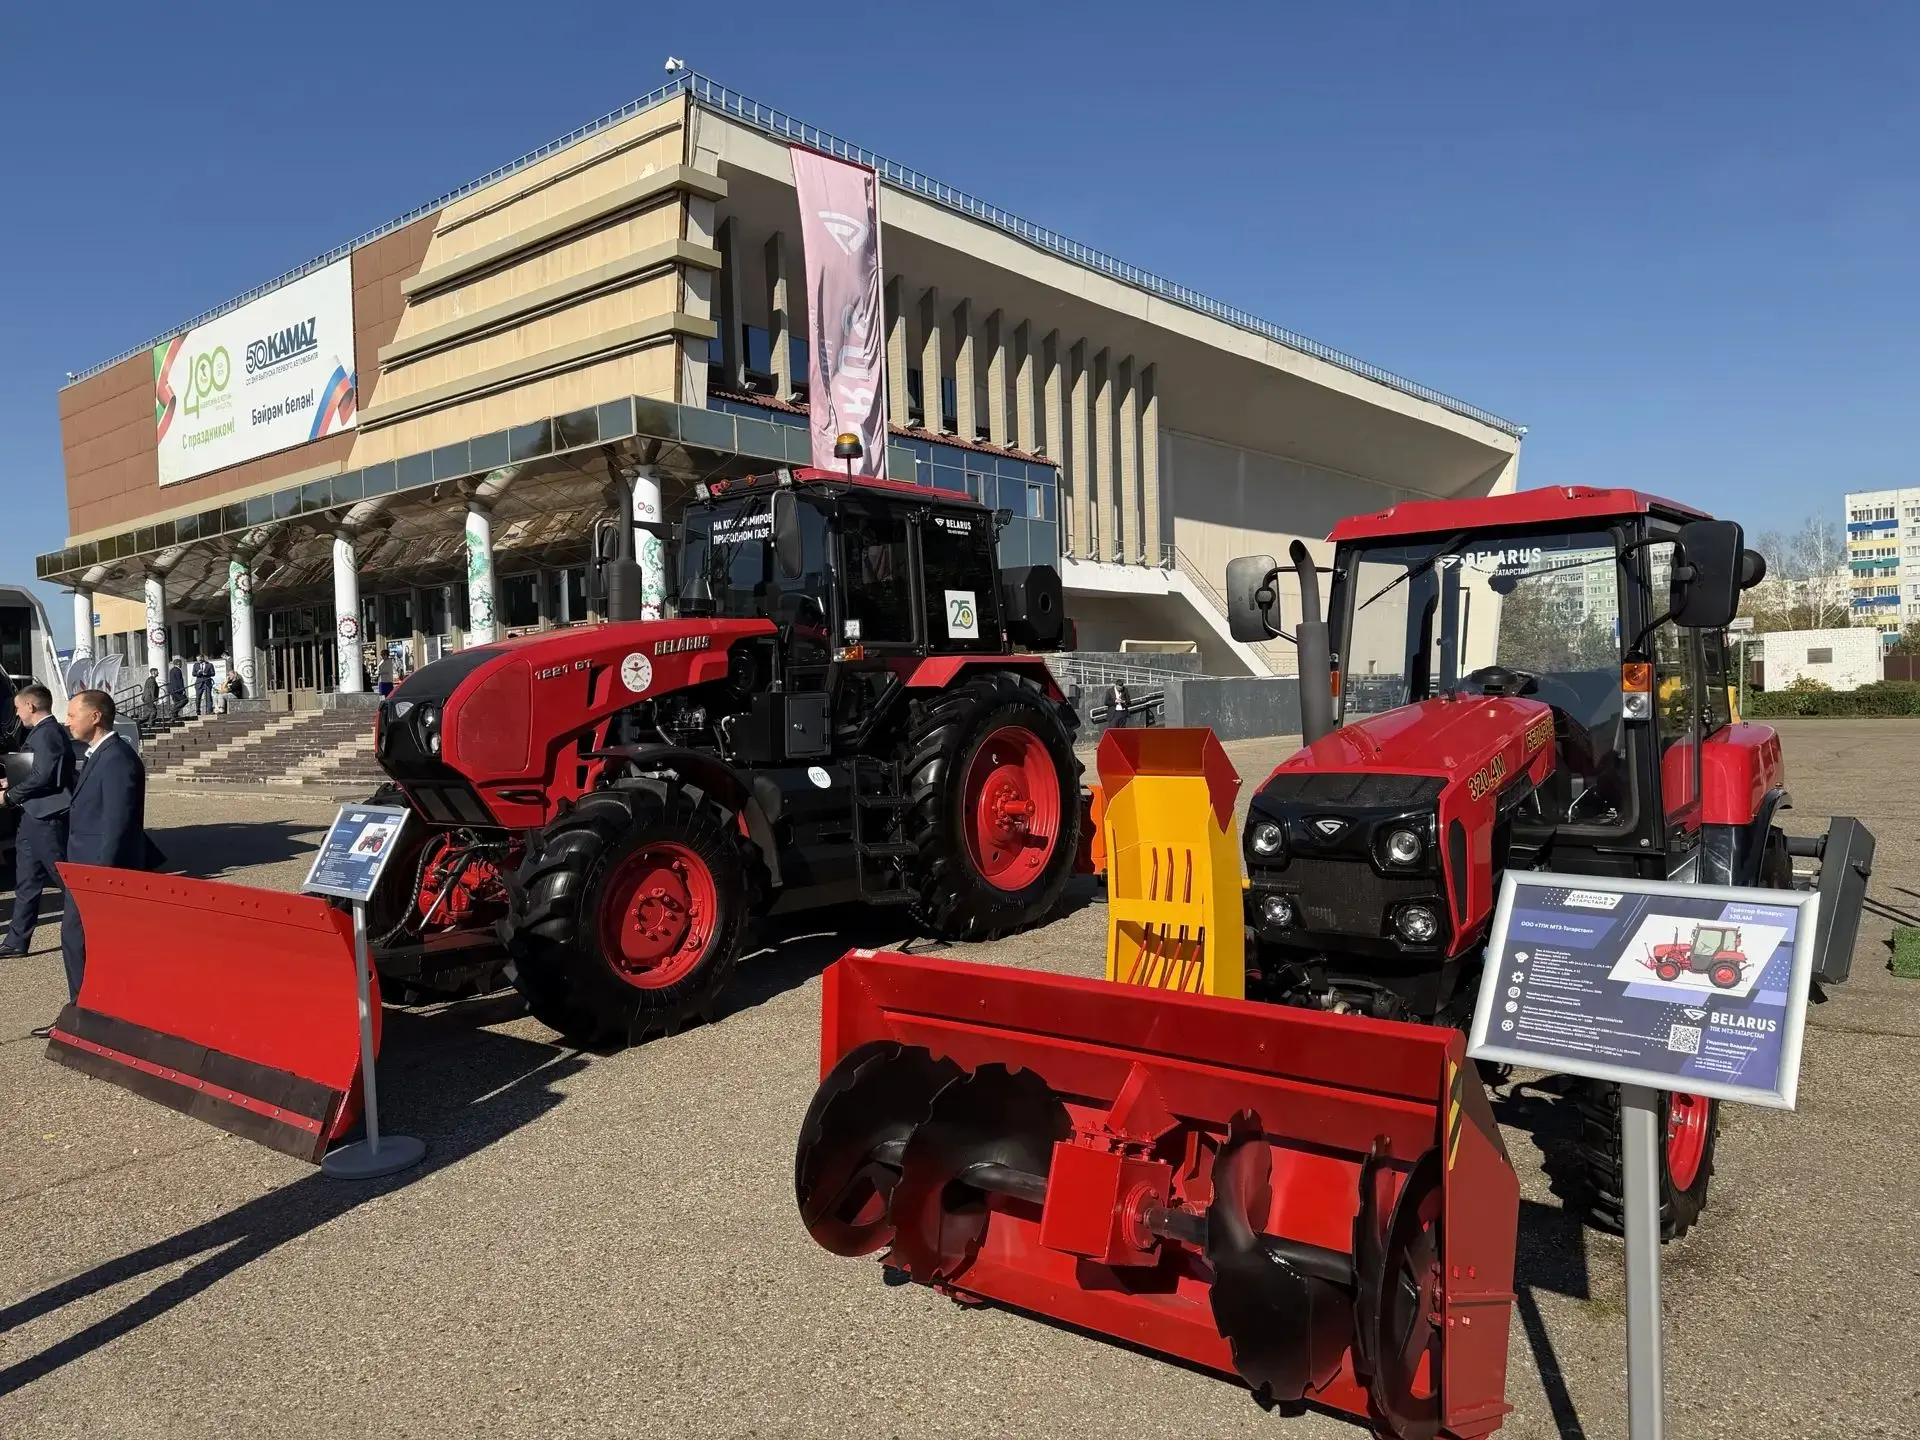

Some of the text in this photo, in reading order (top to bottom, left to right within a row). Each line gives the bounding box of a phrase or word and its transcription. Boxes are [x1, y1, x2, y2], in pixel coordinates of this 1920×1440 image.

[267, 316, 318, 362] KAMAZ
[182, 416, 236, 450] С праздником!
[946, 519, 971, 530] BELARUS
[950, 599, 974, 630] 25
[654, 635, 711, 656] BELARUS
[534, 665, 569, 681] 1221
[1710, 1012, 1777, 1032] BELARUS
